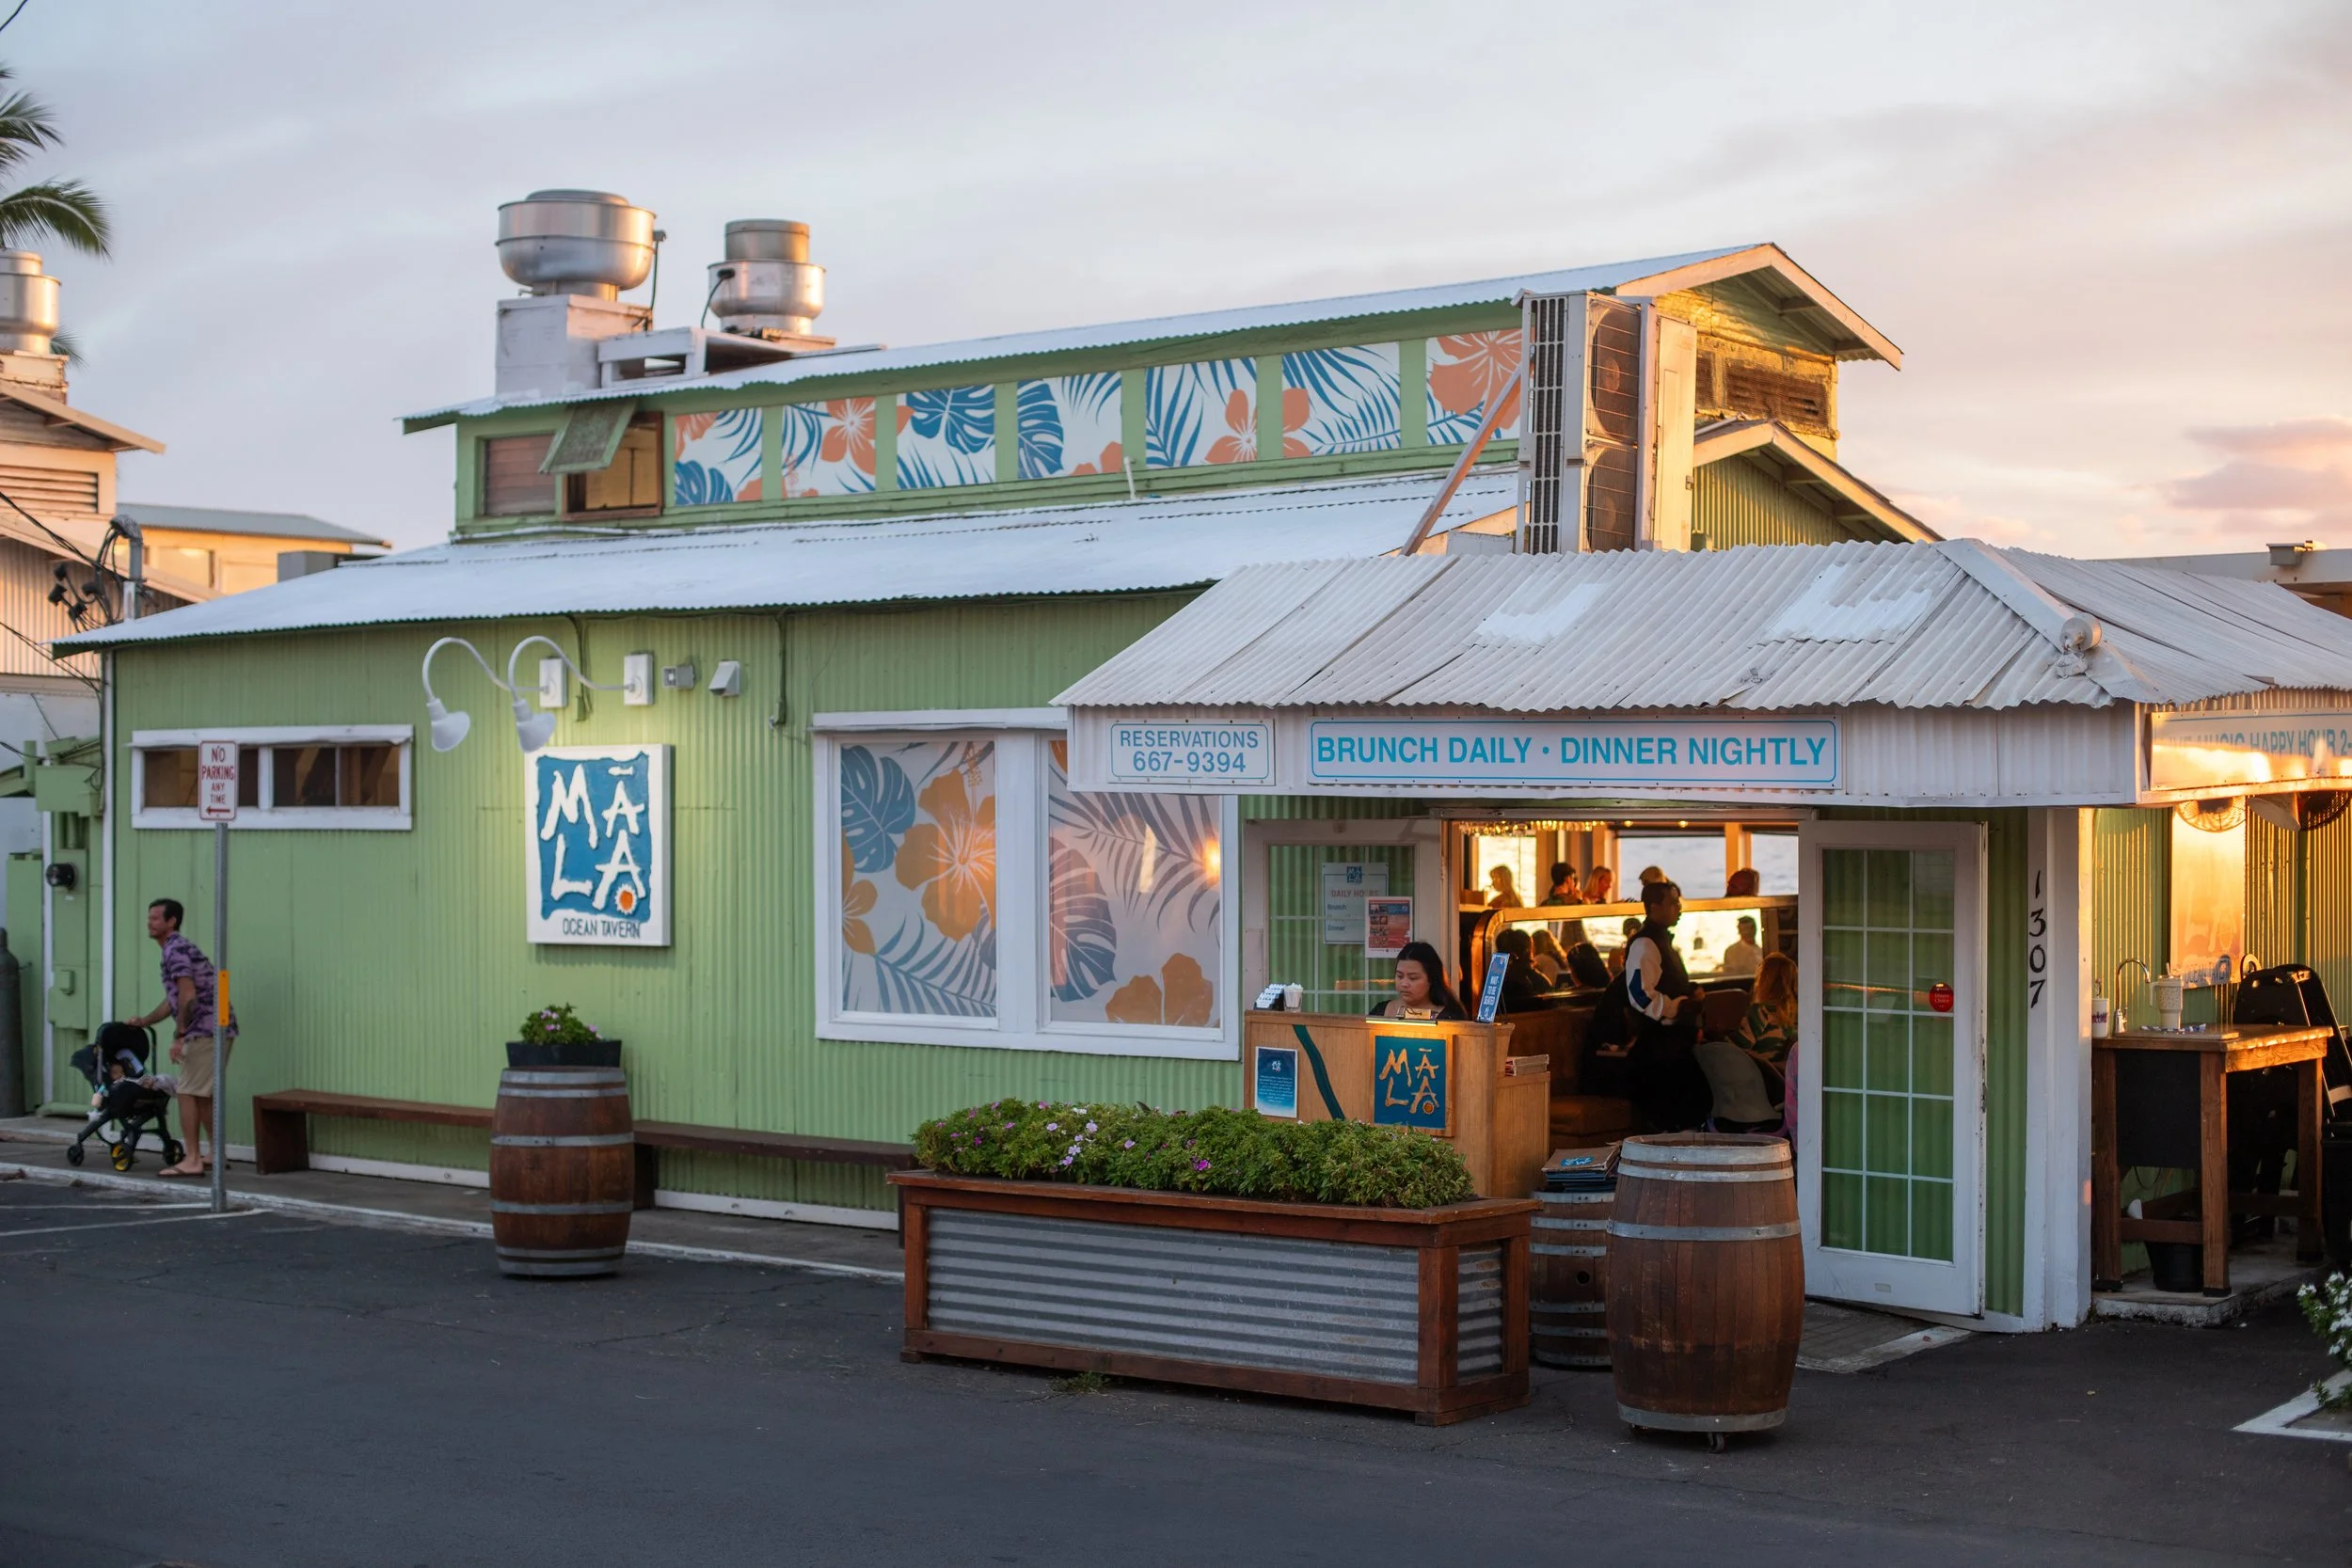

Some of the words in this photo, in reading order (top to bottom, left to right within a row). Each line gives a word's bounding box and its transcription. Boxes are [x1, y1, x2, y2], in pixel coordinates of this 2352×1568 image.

[1120, 730, 1259, 748] RESERVATIONS
[2249, 730, 2295, 755] HAPPY
[211, 748, 225, 763] NO
[1318, 736, 1438, 764] BRUNCH
[1449, 736, 1532, 764] DAILY
[1561, 737, 1677, 765] DINNER
[1689, 737, 1826, 766] NIGHTLY
[1133, 751, 1247, 773] 667-9394
[201, 766, 234, 781] PARKING
[211, 782, 225, 792] ANY
[210, 794, 226, 805] TIME
[1331, 889, 1351, 897] DAILY
[1353, 889, 1379, 897] HORS
[563, 917, 597, 936] OCEAN
[601, 920, 640, 939] TAVERN
[2028, 869, 2046, 1008] 1307
